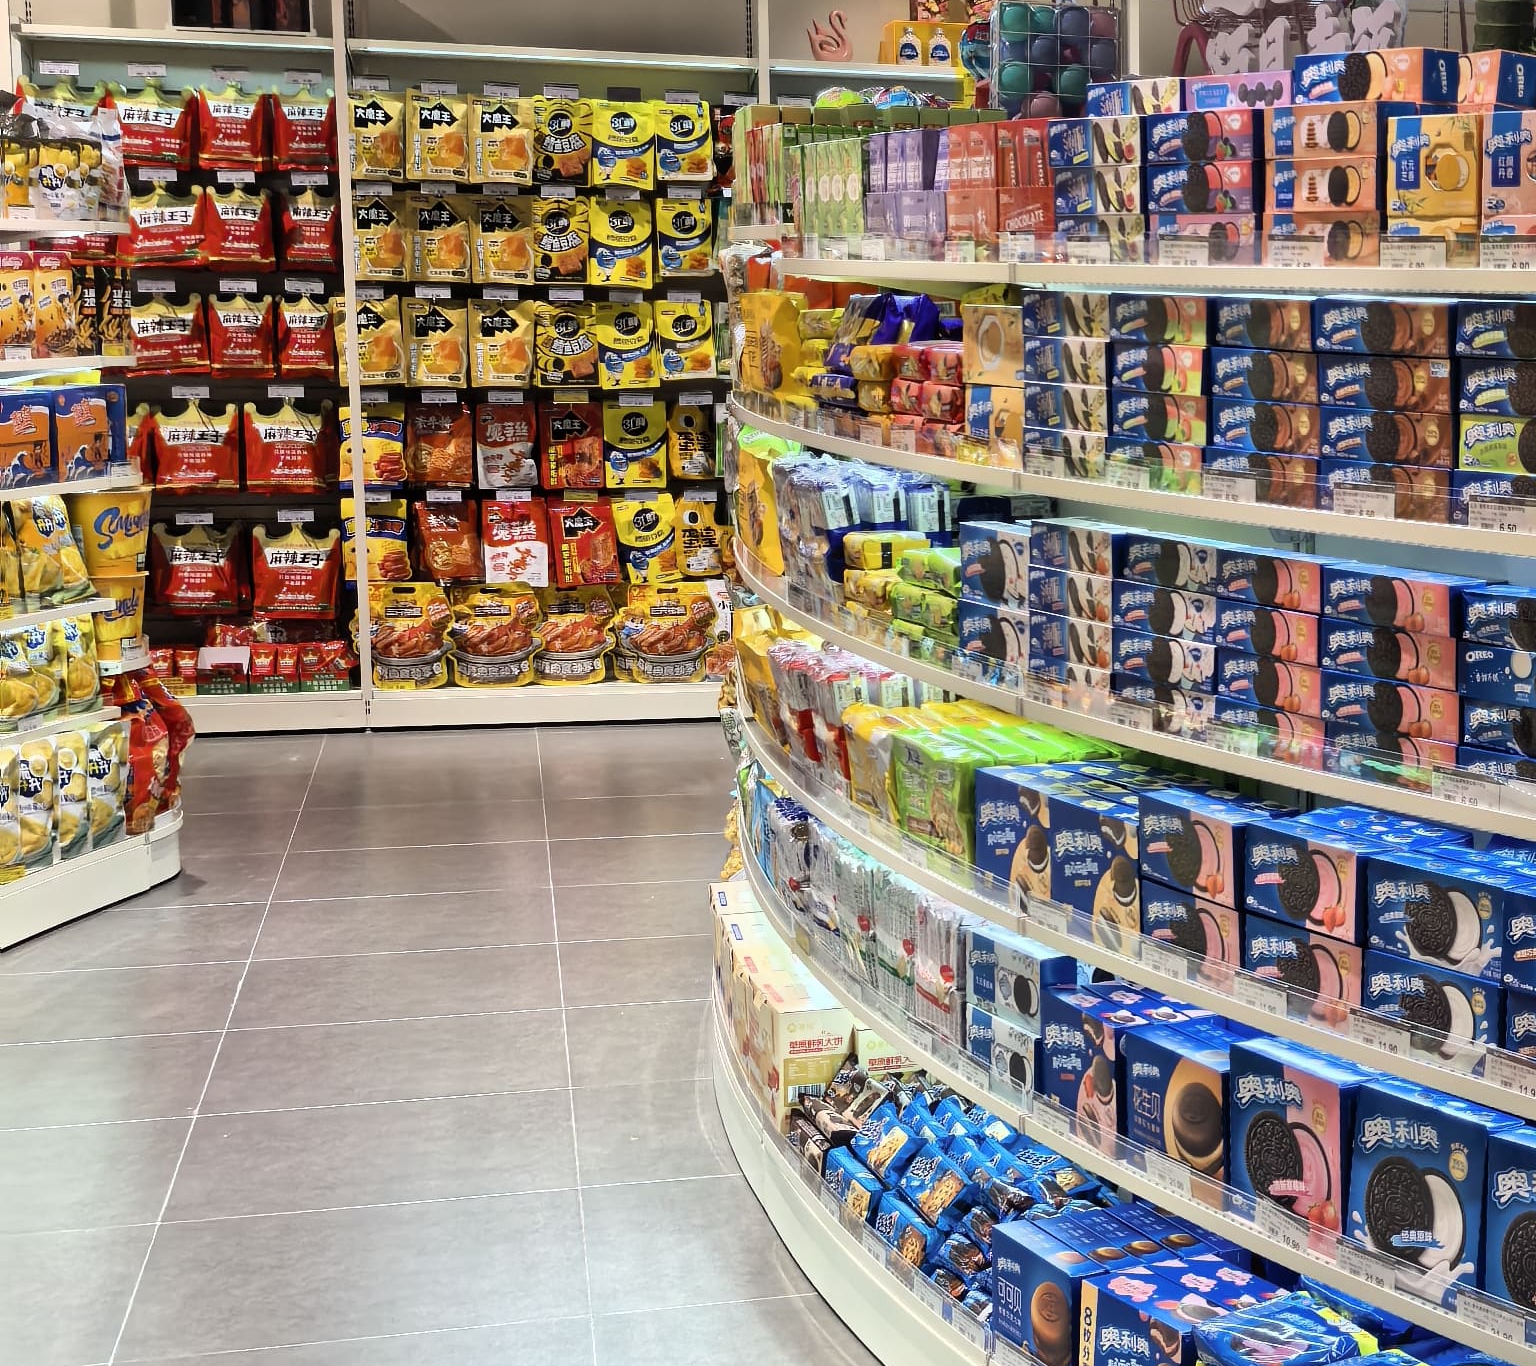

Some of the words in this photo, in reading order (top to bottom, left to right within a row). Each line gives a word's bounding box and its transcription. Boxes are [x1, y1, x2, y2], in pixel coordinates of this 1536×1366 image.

[121, 105, 177, 127] 麻辣王子
[138, 210, 193, 226] 麻辣王子
[137, 318, 190, 334] 麻辣王子
[167, 428, 222, 443] 麻辣王子
[263, 428, 316, 443] 麻辣王子
[269, 553, 324, 566] 麻辣王子
[1468, 601, 1519, 624] 奥利奥
[1465, 650, 1494, 662] OREO
[1469, 708, 1521, 728] 奥利奥
[1252, 844, 1299, 866] 奥利奥
[1374, 881, 1431, 905] 奥利奥
[1250, 937, 1298, 959] 奥利奥
[1370, 973, 1426, 996] 奥利奥
[1236, 1075, 1303, 1109] 奥利奥
[1362, 1116, 1440, 1152] 奥利奥
[1101, 1327, 1150, 1357] 奥利奥
